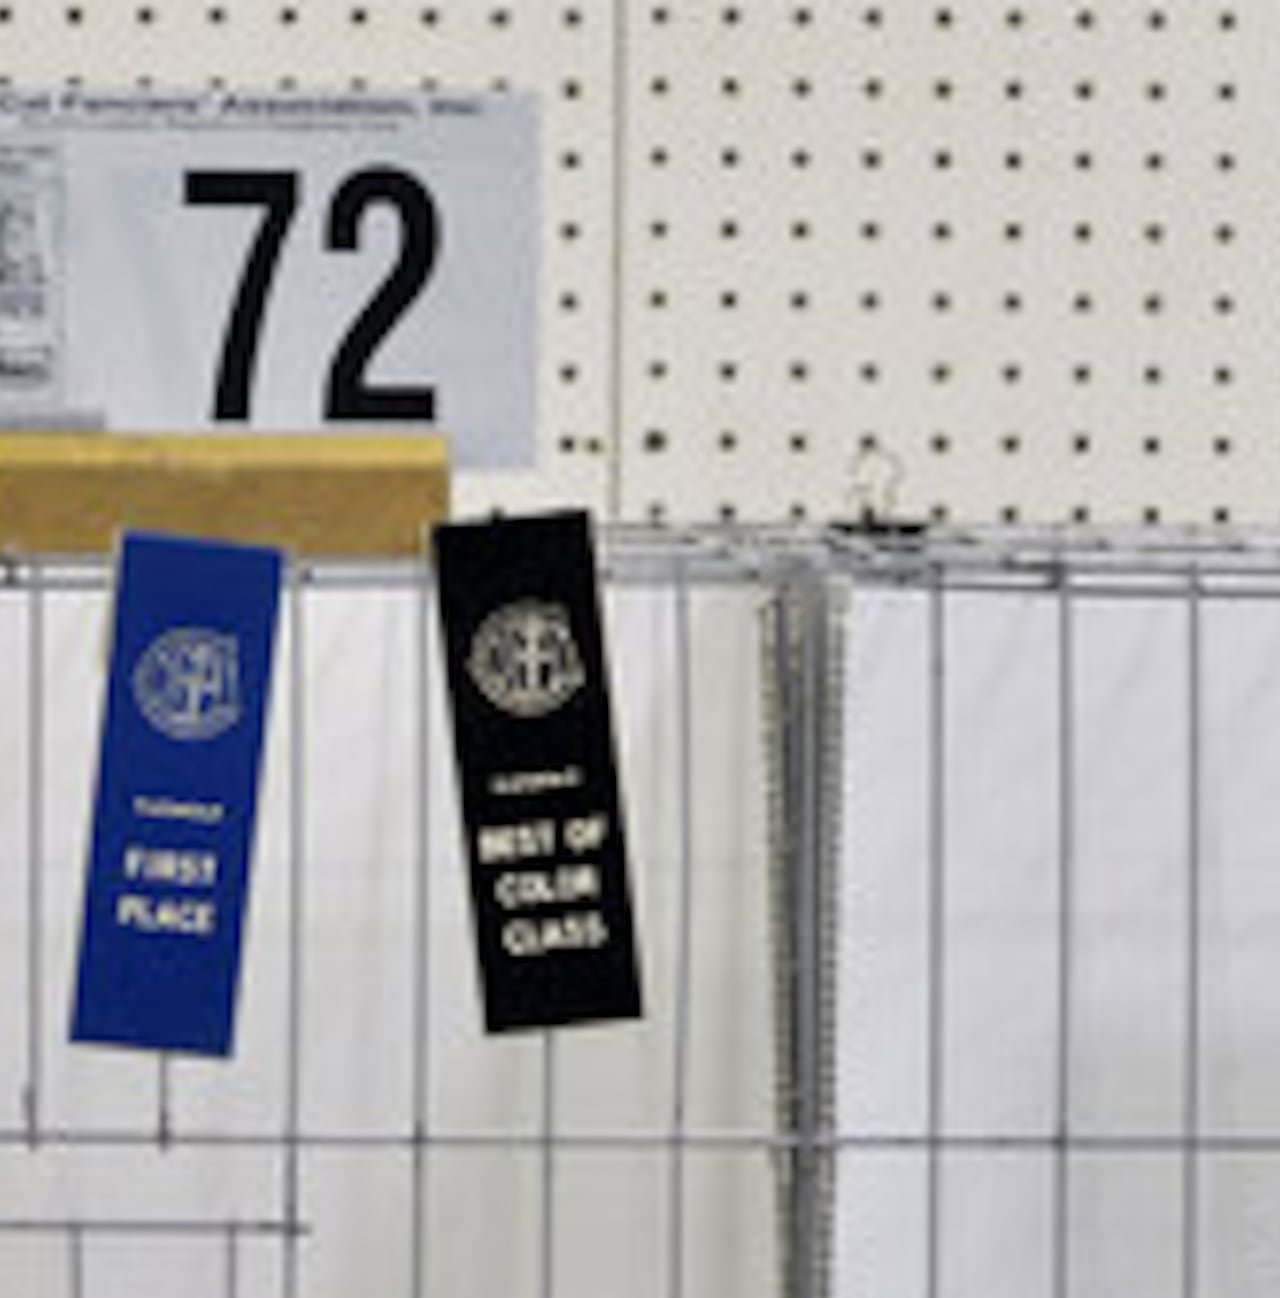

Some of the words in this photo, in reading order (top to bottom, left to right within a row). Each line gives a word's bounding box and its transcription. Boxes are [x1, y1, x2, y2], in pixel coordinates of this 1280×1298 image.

[183, 163, 441, 422] 72
[477, 817, 557, 865] BEST
[563, 811, 609, 856] OF
[123, 843, 218, 888] FIRST
[493, 863, 602, 911] COLOR
[117, 893, 218, 936] PLACE
[500, 909, 610, 958] CLASS
